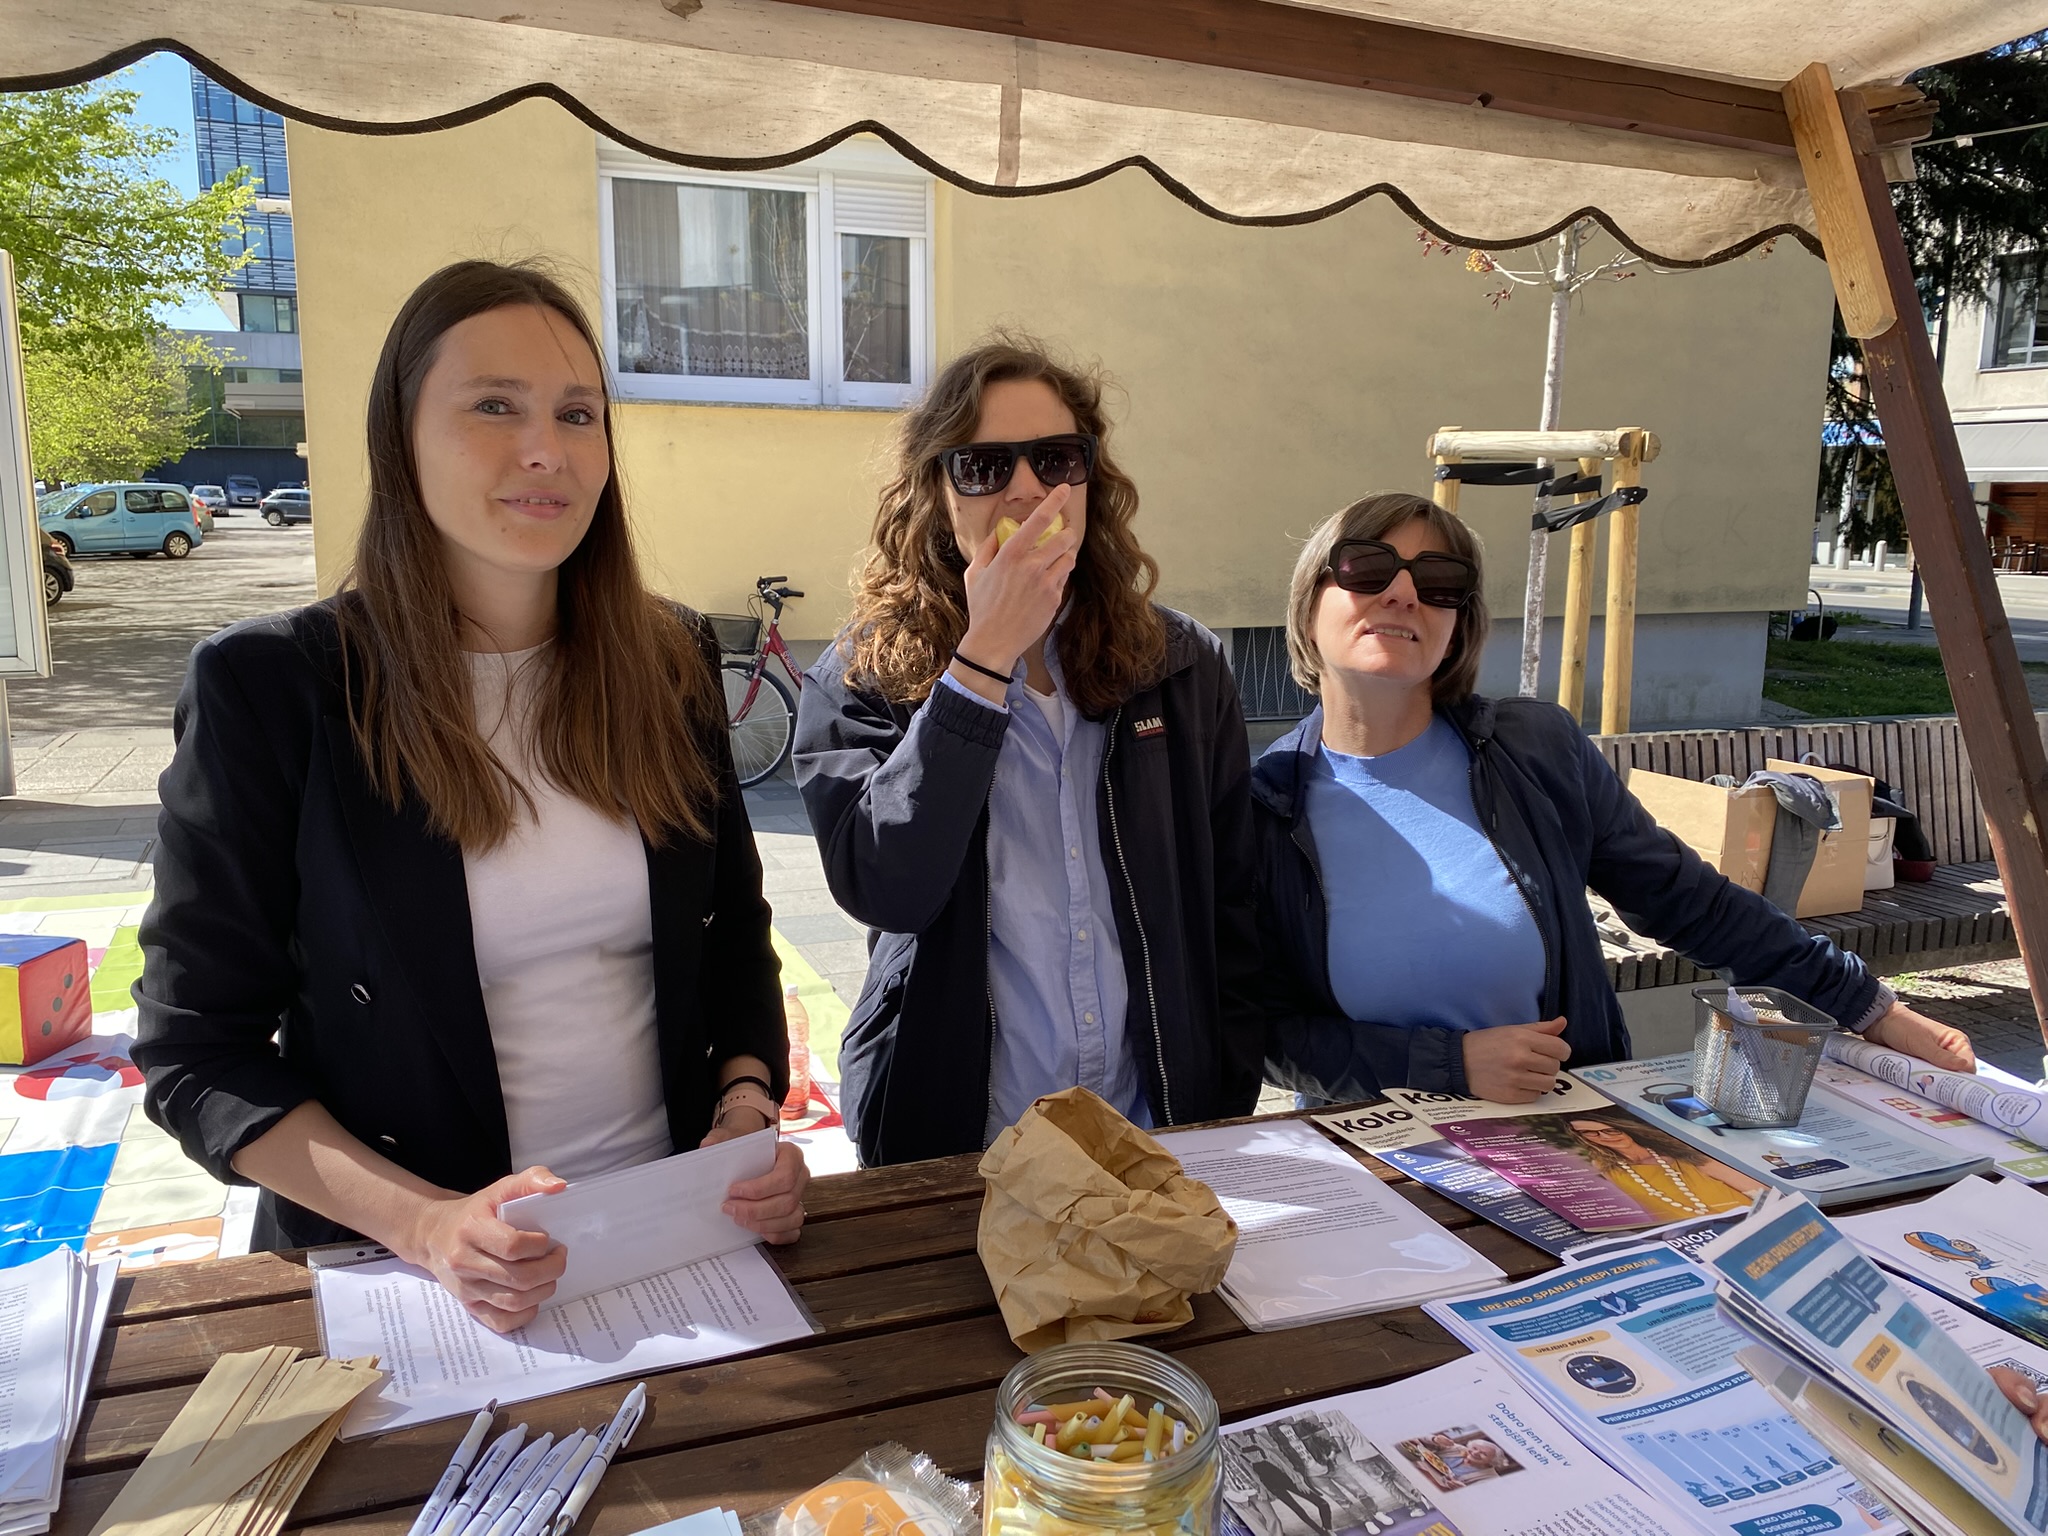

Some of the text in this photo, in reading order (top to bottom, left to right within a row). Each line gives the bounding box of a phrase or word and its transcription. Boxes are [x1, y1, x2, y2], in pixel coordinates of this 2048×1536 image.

[1134, 717, 1163, 732] SLAM
[1582, 1069, 1617, 1082] 10
[1330, 1110, 1414, 1133] Kolo
[1478, 1295, 1533, 1314] UREJENO
[1532, 1280, 1578, 1301] SPANJE
[1576, 1271, 1611, 1289] KREPI
[1610, 1258, 1660, 1276] ZDRAVJE
[1647, 1309, 1687, 1327] UREJENEGA
[1660, 1302, 1688, 1314] KORISTI
[1536, 1336, 1596, 1354] UREJENO SPANJE
[1604, 1406, 1659, 1424] PRIPOROČENA
[1658, 1396, 1692, 1411] DOLŽINA
[1691, 1385, 1721, 1401] SPANJA
[1720, 1380, 1732, 1390] PO
[1488, 1412, 1550, 1466] starejših letih
[1496, 1402, 1525, 1428] Dobro
[1521, 1425, 1543, 1445] jem
[1542, 1441, 1565, 1463] tudi
[1584, 1503, 1615, 1528] vitamine
[1604, 1497, 1628, 1515] skupin
[1631, 1504, 1656, 1526] pestro
[1754, 1509, 1807, 1527] KAKO LAHKO
[1759, 1514, 1822, 1535] POSKRBIMO ZA
